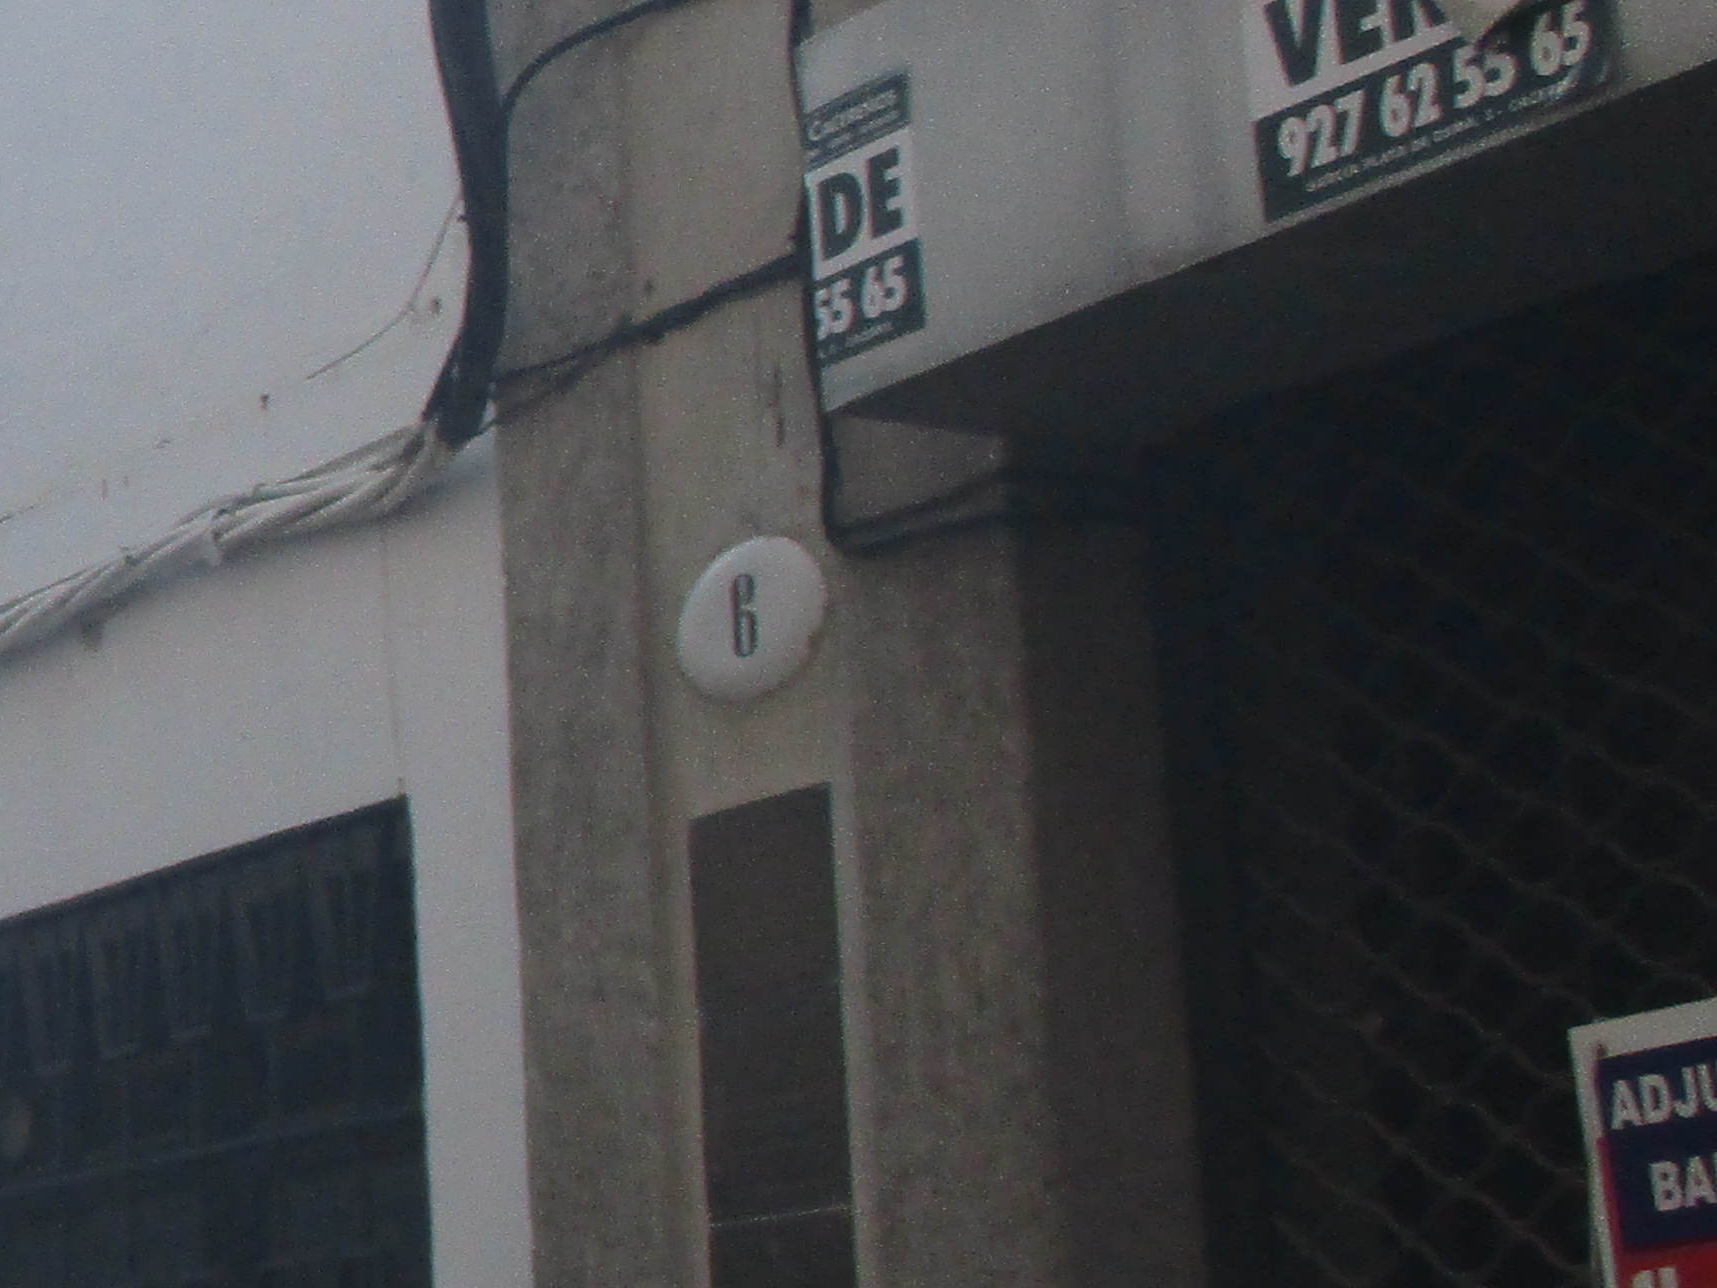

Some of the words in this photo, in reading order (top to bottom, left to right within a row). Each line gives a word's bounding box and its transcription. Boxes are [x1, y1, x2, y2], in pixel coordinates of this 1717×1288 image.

[1277, 89, 1364, 177] 927
[1379, 62, 1443, 138] 62
[1453, 45, 1519, 109] 55
[818, 145, 906, 261] DE
[860, 255, 908, 319] 65
[731, 572, 758, 658] 6
[1649, 1153, 1717, 1213] BA
